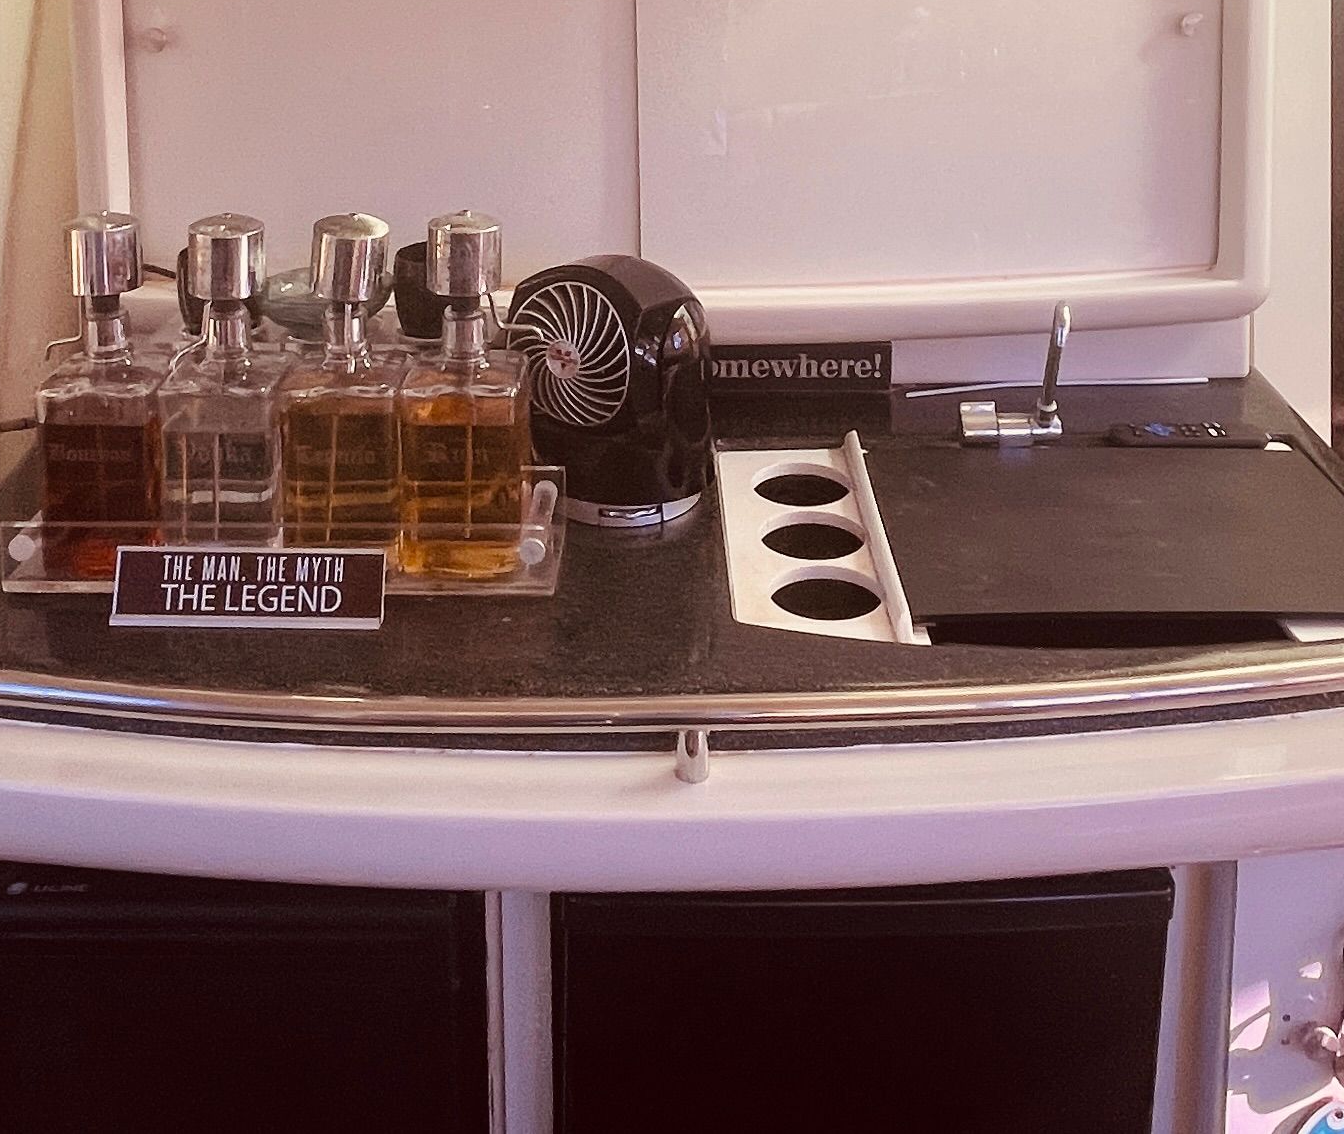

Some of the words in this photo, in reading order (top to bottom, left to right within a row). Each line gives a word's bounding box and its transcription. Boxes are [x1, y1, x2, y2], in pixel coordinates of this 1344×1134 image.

[712, 353, 882, 378] mewhere!
[163, 554, 194, 581] THE
[256, 555, 288, 583] THE
[295, 556, 344, 583] MYTH
[160, 583, 217, 612] THE
[224, 584, 343, 613] LEGEND
